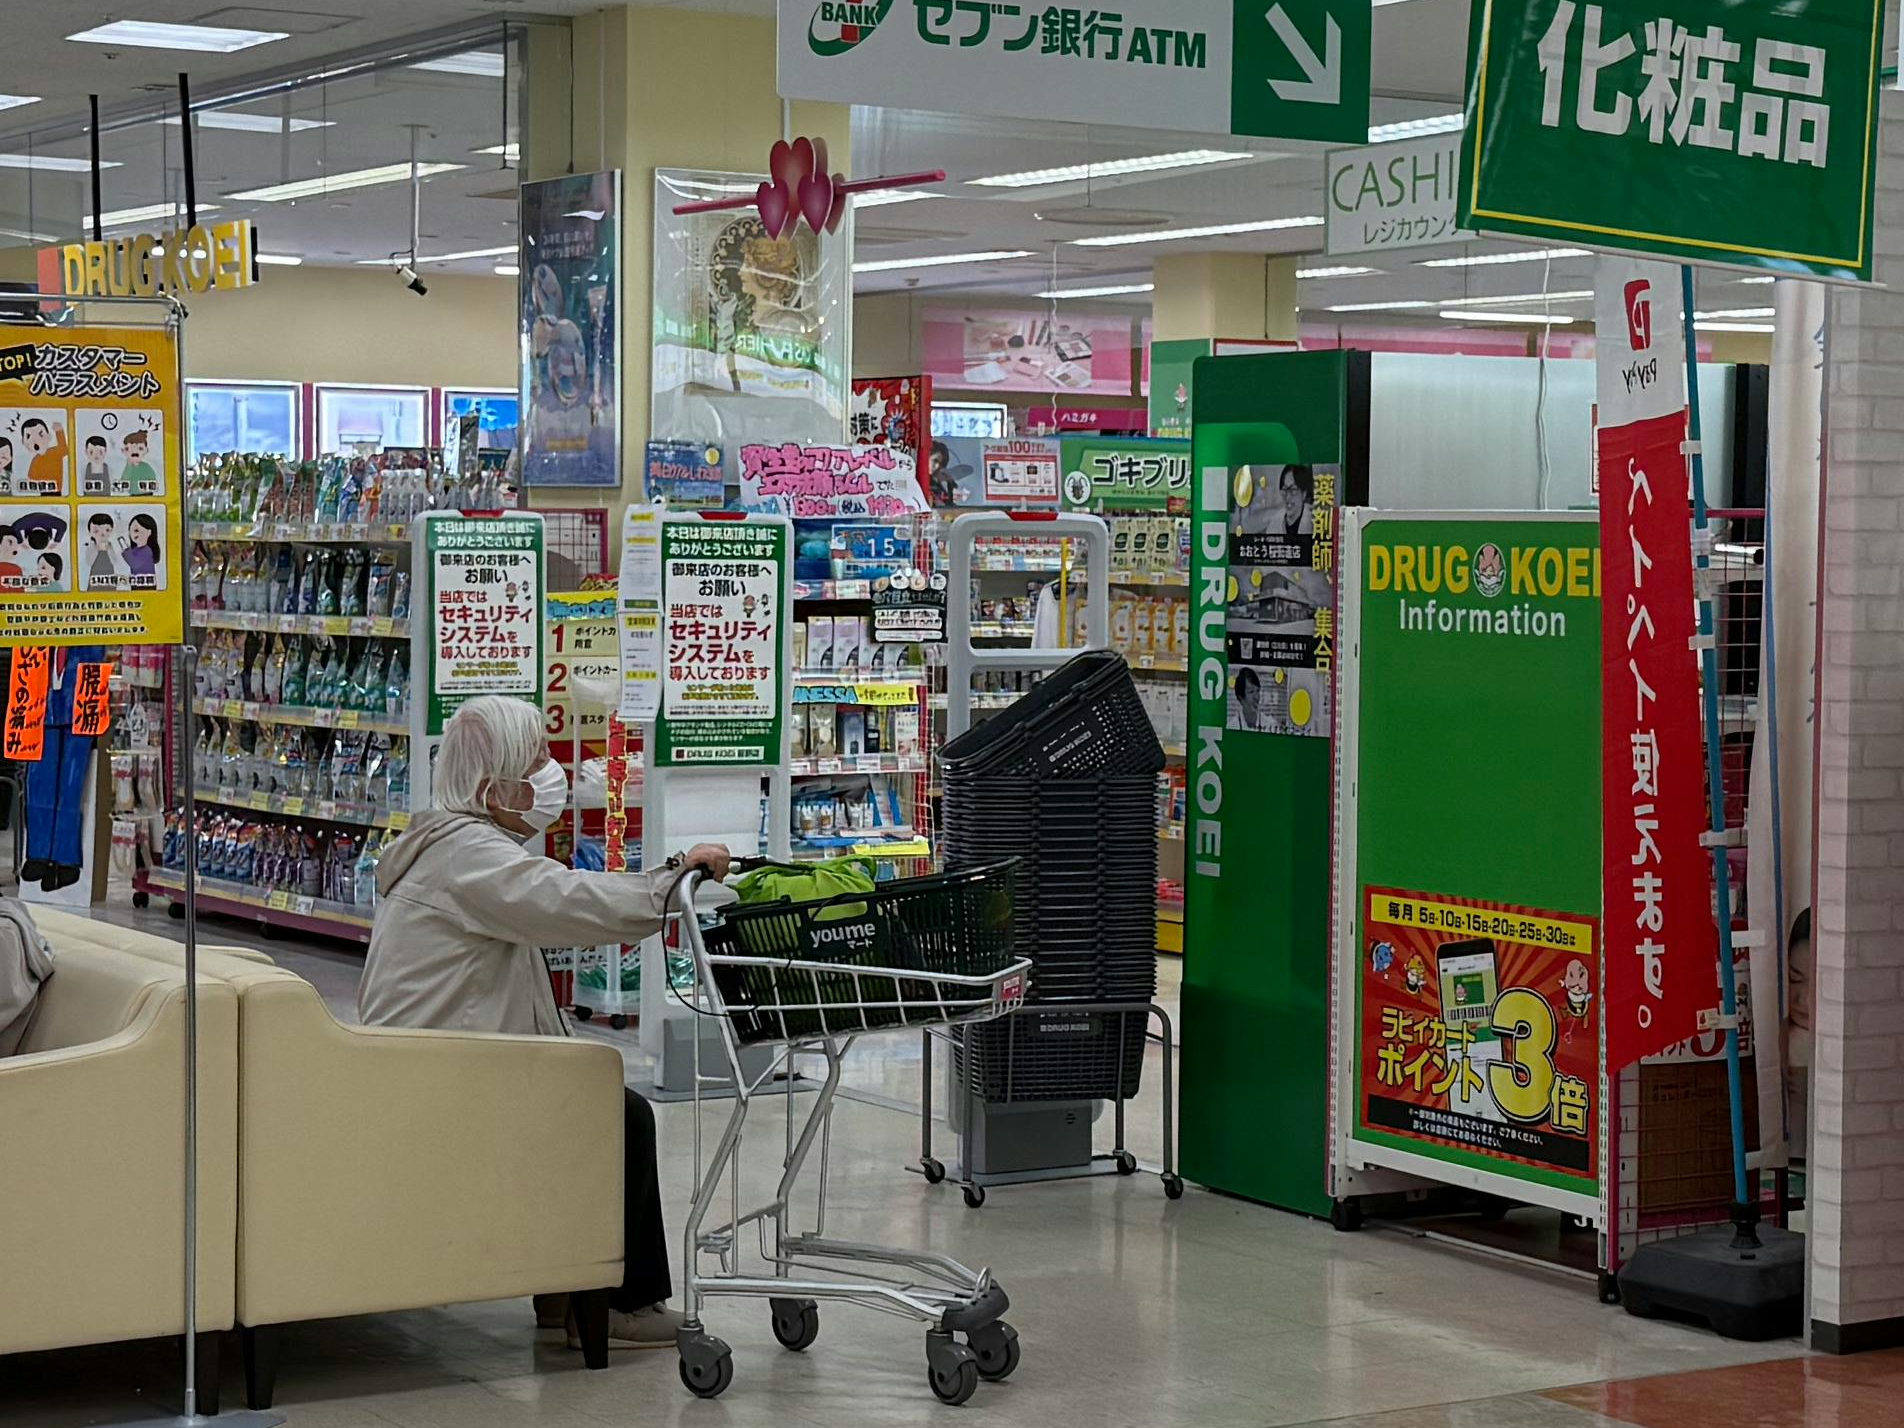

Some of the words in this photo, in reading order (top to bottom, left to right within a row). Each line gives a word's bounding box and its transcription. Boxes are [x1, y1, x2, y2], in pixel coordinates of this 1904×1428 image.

[820, 0, 879, 28] BANK
[33, 344, 147, 372] カスタマー
[30, 371, 161, 398] ハラスメント
[1092, 455, 1189, 488] ゴキブリ
[437, 536, 534, 548] ありがとうございます
[668, 542, 775, 557] ありがとうございます
[440, 553, 532, 566] 御来店のお客様へ
[671, 562, 772, 577] 御来店のお客様へ
[1369, 545, 1469, 594] DRUG
[464, 568, 509, 584] お願い
[698, 579, 746, 597] お願い
[440, 590, 488, 603] 当店では
[439, 605, 533, 623] セキュリティ
[670, 603, 723, 618] 当店では
[1198, 522, 1227, 702] DRUG
[1399, 599, 1567, 637] Information
[440, 626, 518, 644] システムを
[552, 623, 564, 653] 1
[669, 621, 772, 641] セキュリティ
[669, 643, 754, 664] システムを
[546, 662, 567, 692] 2
[546, 704, 565, 734] 3
[1192, 725, 1223, 879] KOEI
[809, 922, 876, 947] youme
[1377, 1043, 1485, 1103] ポイント
